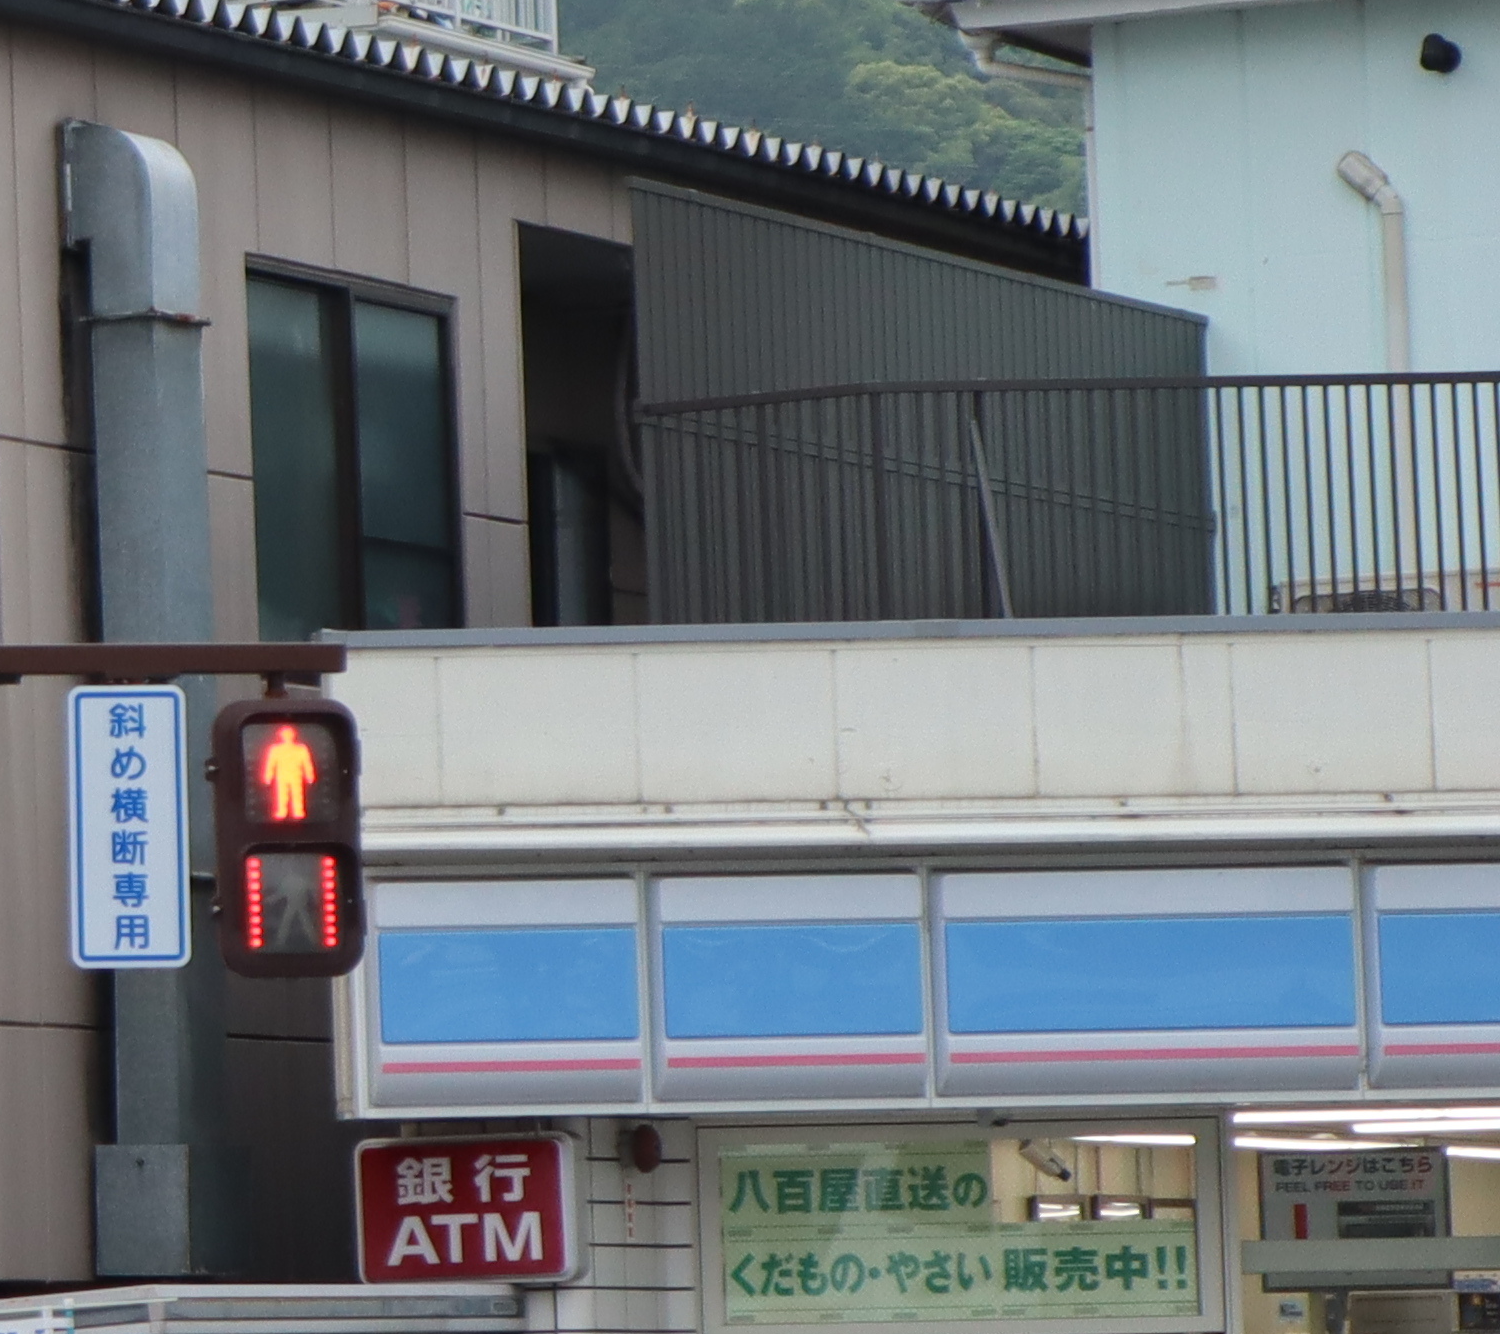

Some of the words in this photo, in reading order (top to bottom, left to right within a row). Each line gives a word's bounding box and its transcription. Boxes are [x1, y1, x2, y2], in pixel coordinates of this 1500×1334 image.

[106, 702, 151, 951] 斜め横断専用
[396, 1154, 531, 1206] 銀行
[728, 1164, 989, 1216] 八百屋直送の
[1273, 1156, 1433, 1177] 電子レンジはこちら
[1275, 1181, 1311, 1193] FEEL
[1314, 1180, 1351, 1193] FREE
[1355, 1179, 1375, 1191] TO
[1378, 1178, 1409, 1191] USE
[1410, 1178, 1425, 1190] IT
[386, 1211, 544, 1267] ATM
